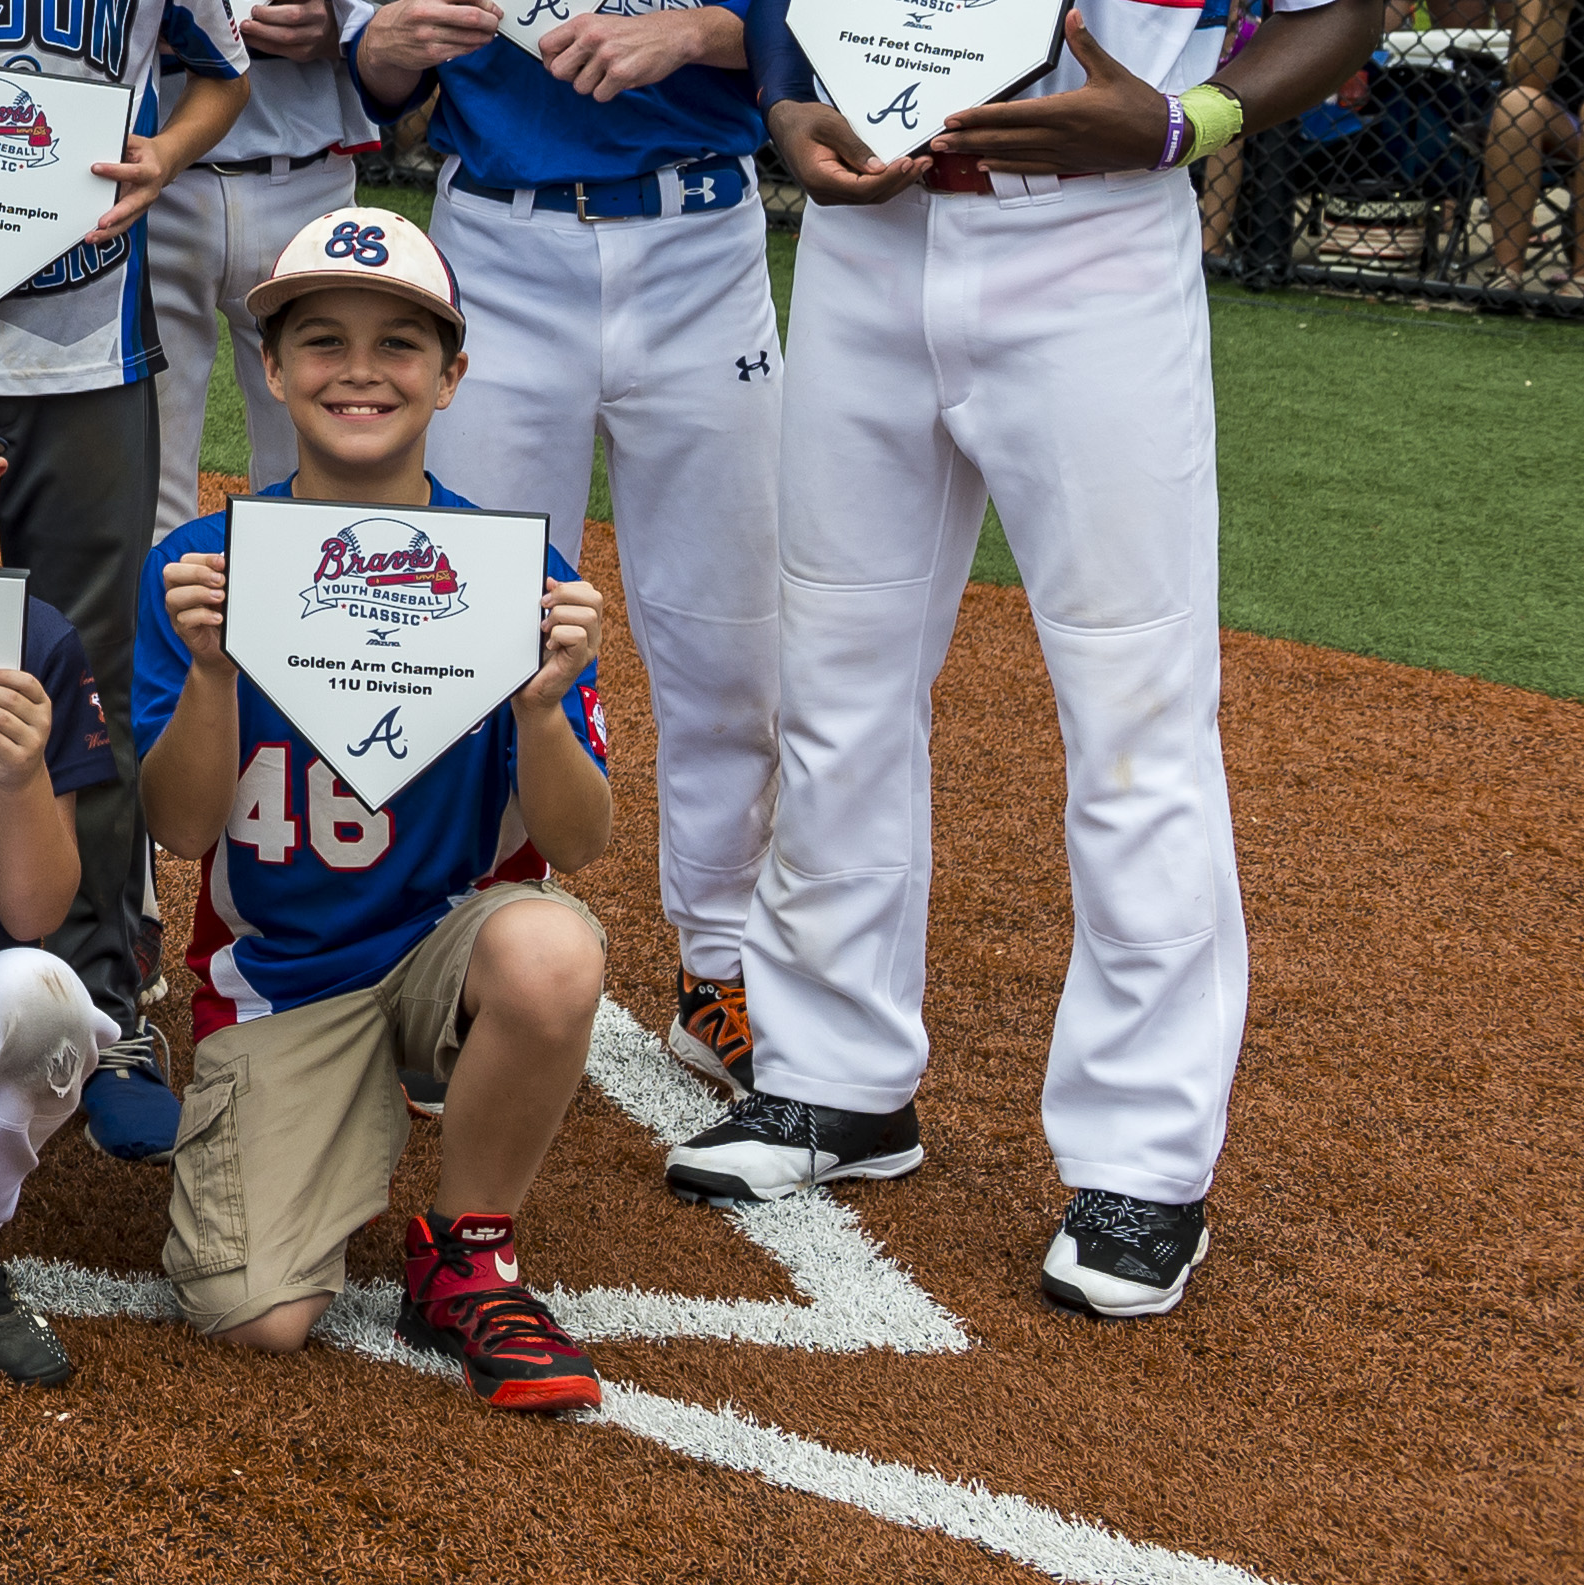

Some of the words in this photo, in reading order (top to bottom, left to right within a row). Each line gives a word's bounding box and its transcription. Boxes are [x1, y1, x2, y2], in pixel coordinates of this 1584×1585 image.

[839, 30, 875, 46] Fleet
[878, 36, 910, 52] Feet
[914, 42, 985, 62] Champion
[864, 52, 891, 66] 14U
[895, 57, 951, 75] Division
[314, 537, 434, 583] Braves
[348, 604, 421, 626] CLASSIC
[288, 655, 346, 671] Golden
[351, 659, 386, 673] Arm
[391, 661, 475, 679] Champion
[328, 678, 361, 691] 11U
[366, 680, 433, 696] Division
[224, 740, 395, 873] 46
